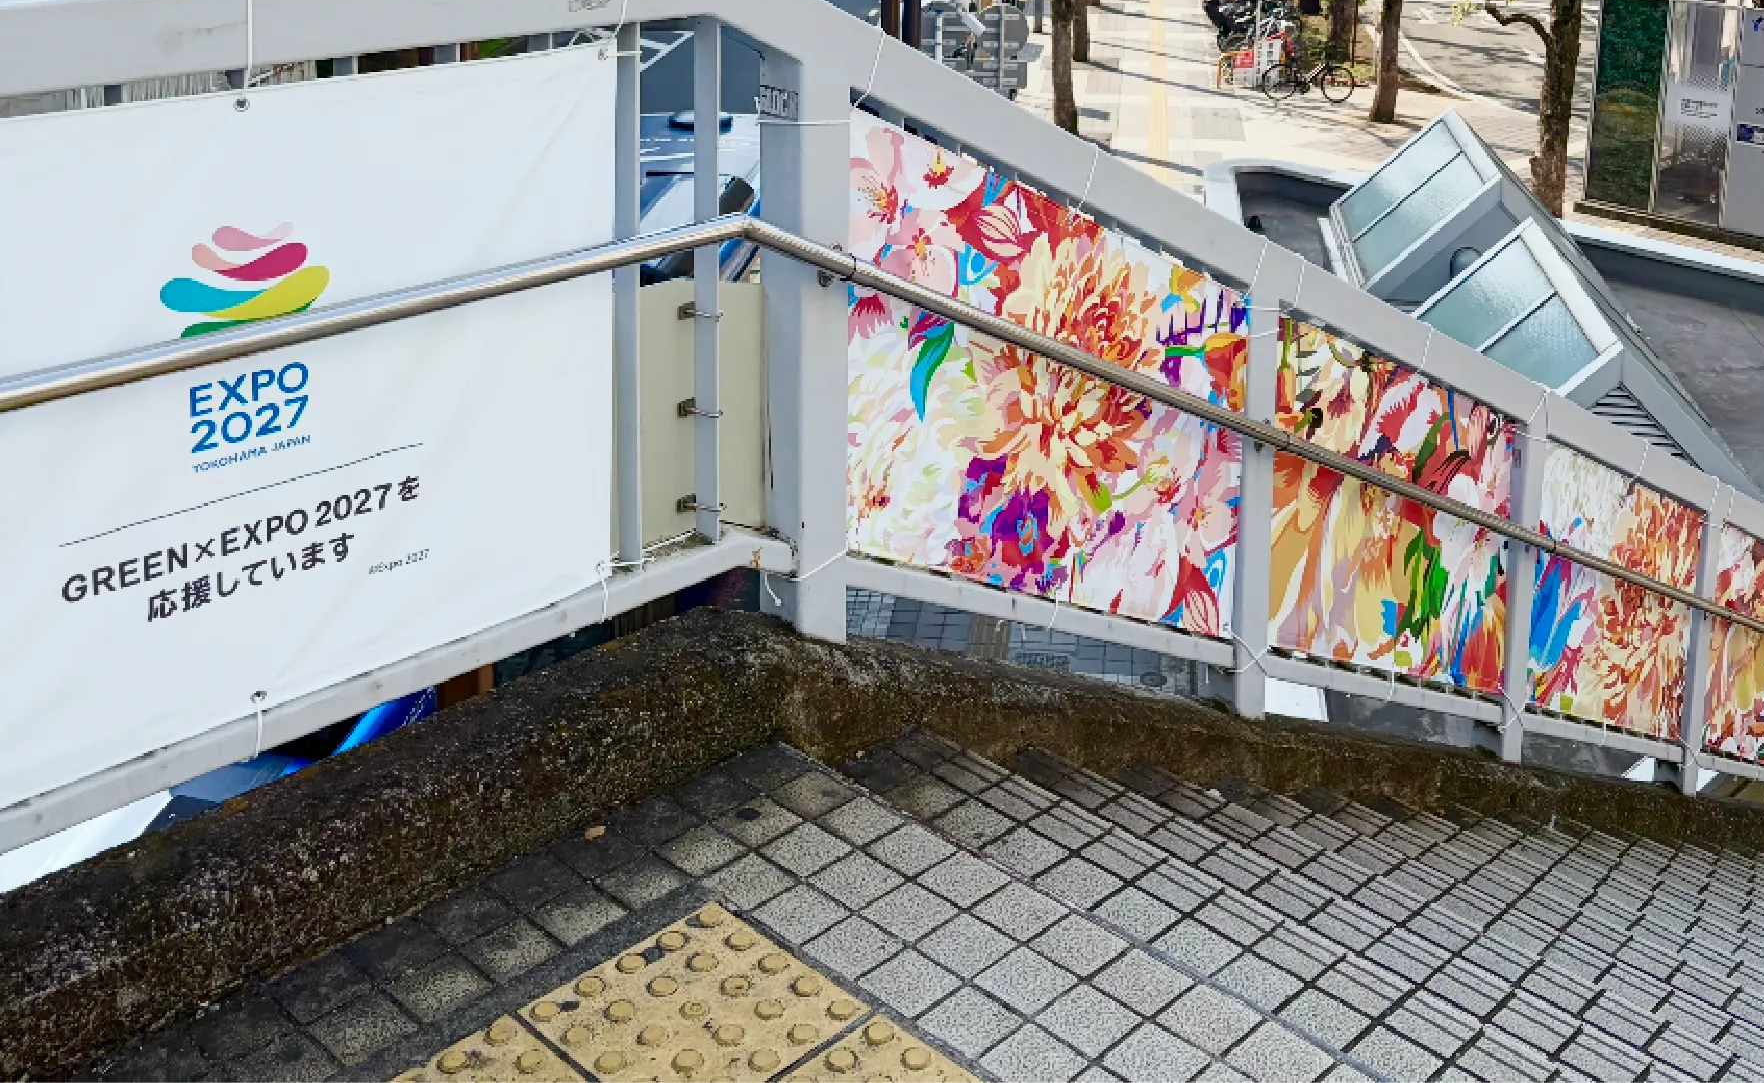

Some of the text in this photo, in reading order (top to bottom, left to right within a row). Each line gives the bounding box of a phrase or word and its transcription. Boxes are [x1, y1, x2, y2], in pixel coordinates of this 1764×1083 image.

[190, 362, 309, 417] EXPO
[191, 395, 309, 453] 2027
[192, 435, 311, 473] YOKOHAMA JAPAN
[147, 532, 355, 622] 応援しています
